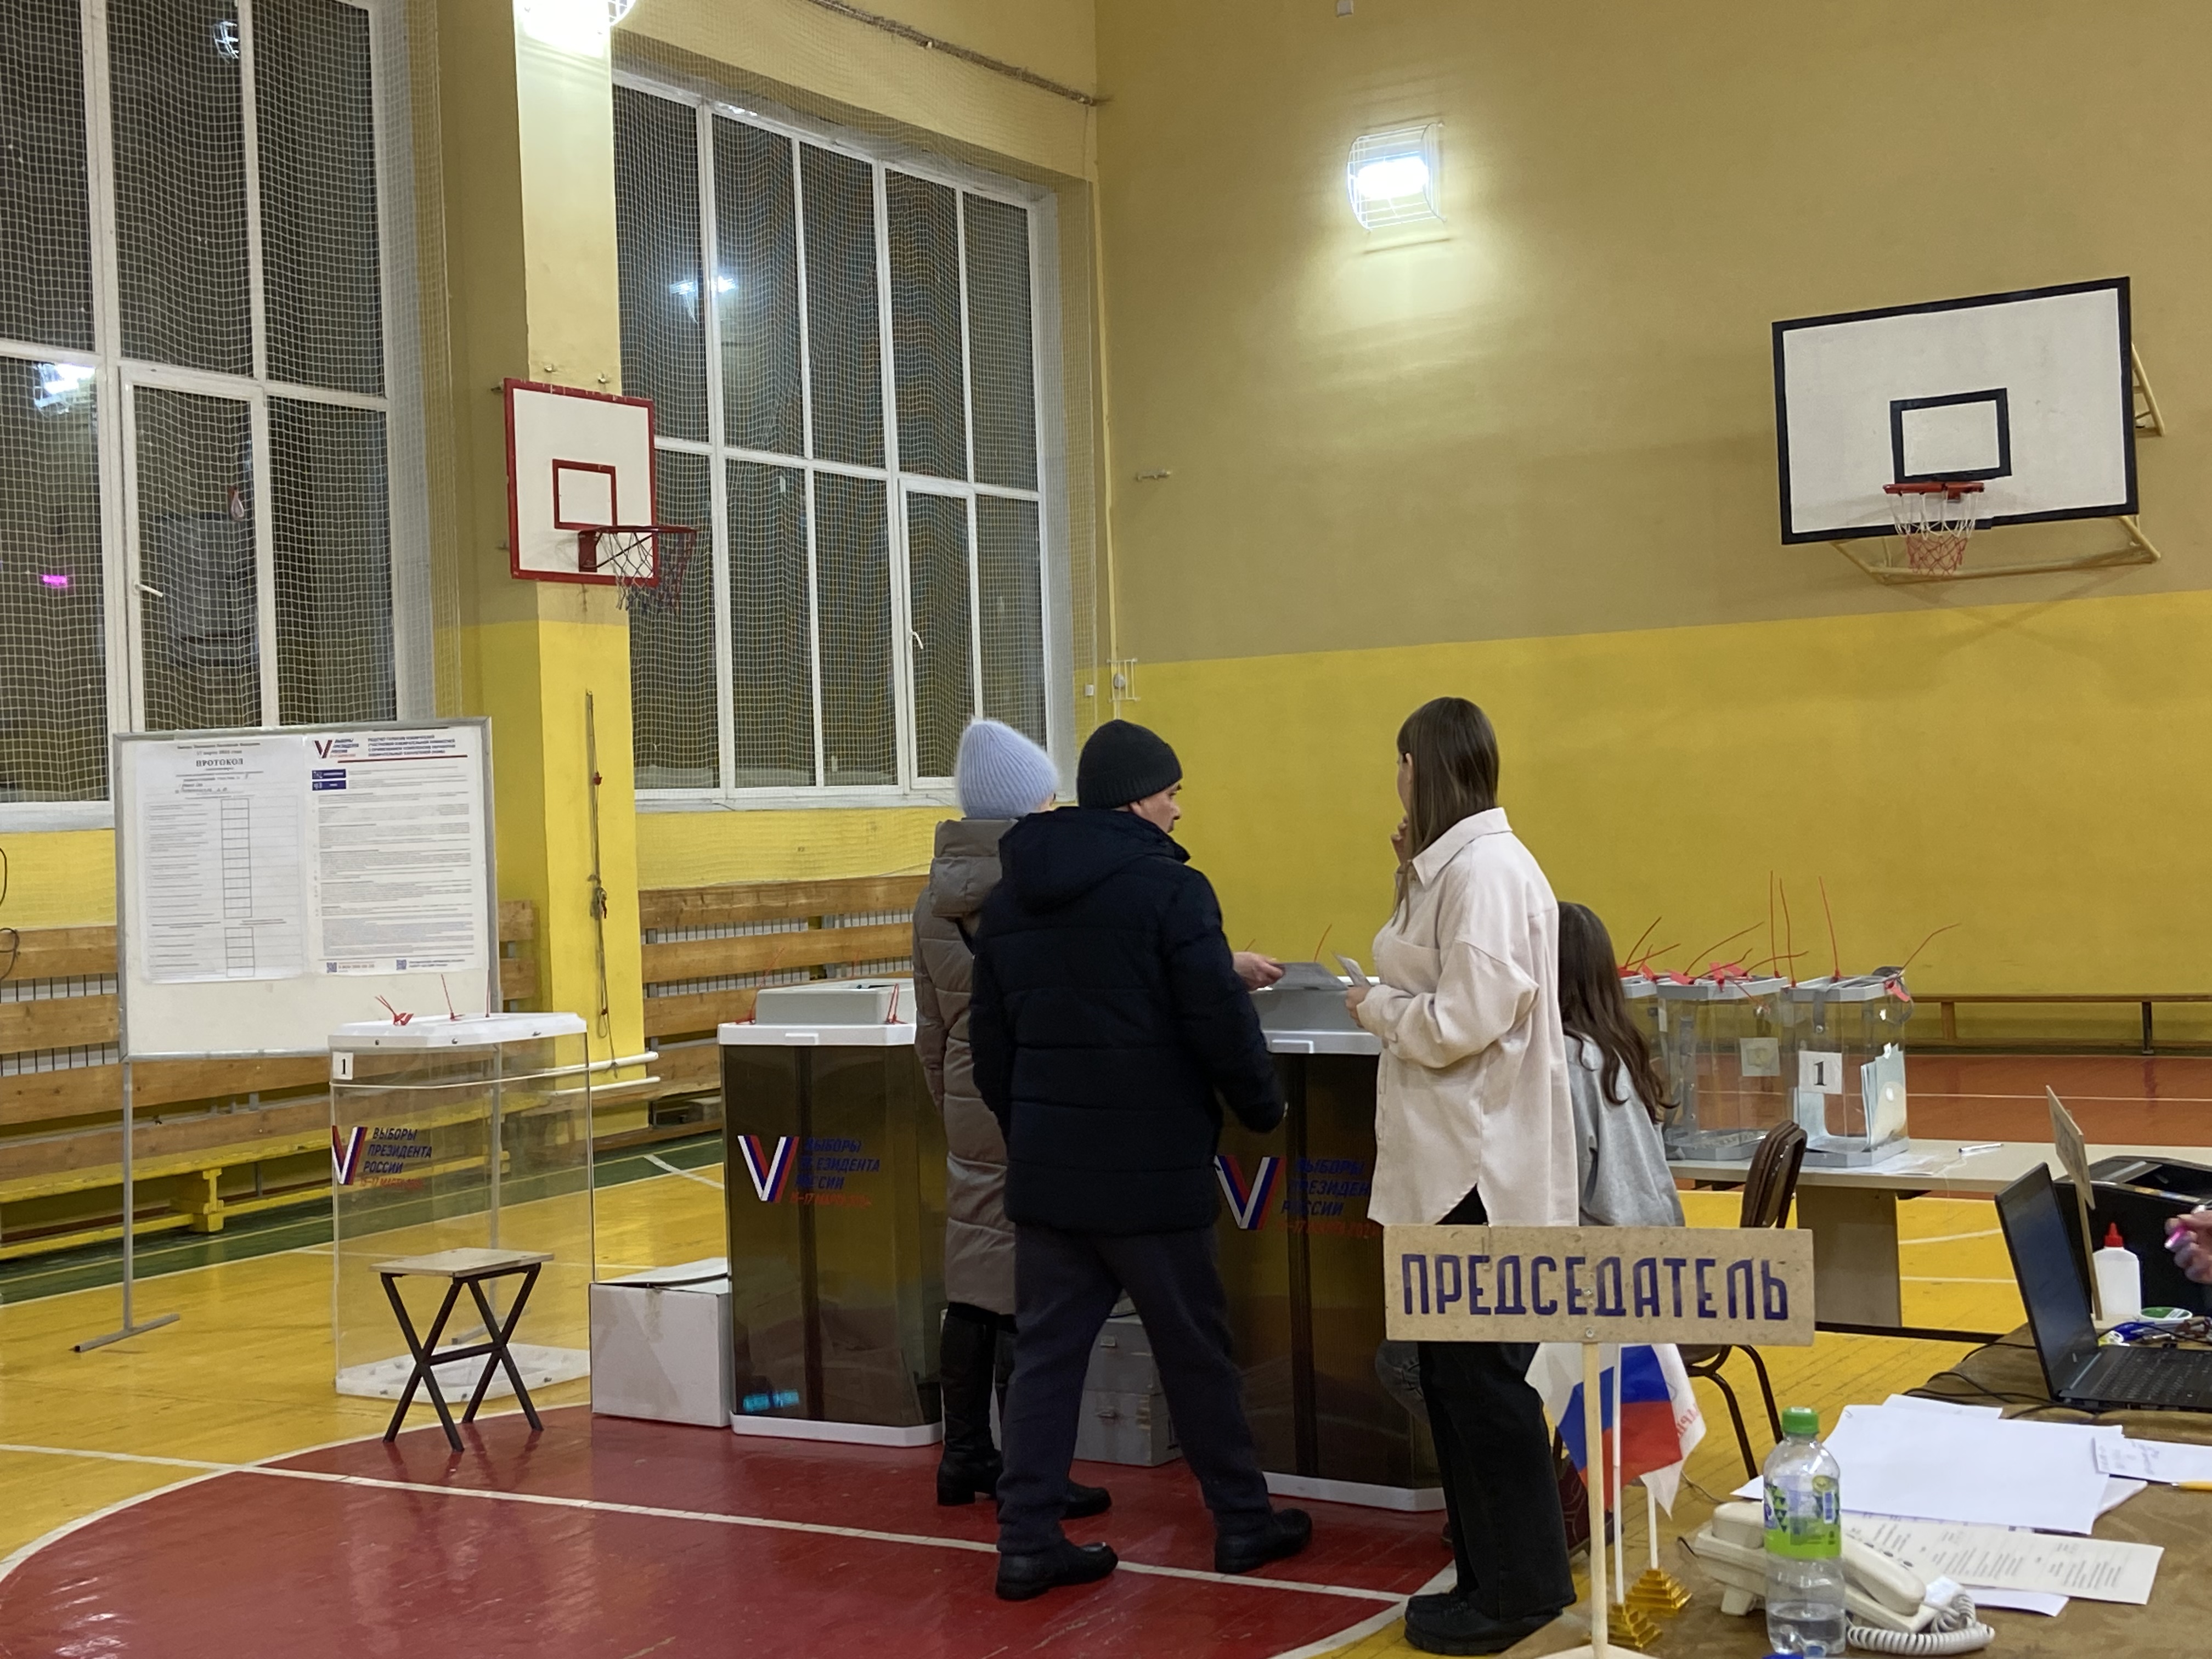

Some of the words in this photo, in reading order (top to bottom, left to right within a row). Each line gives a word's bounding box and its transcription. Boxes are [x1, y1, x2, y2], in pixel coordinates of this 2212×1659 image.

[196, 758, 243, 767] ПРОТОКОЛ
[341, 1058, 346, 1075] 1
[1814, 1061, 1827, 1086] 1
[373, 1127, 417, 1141] ВЫБОРЫ
[368, 1144, 432, 1159] ПРЕЗИДЕНТА
[364, 1161, 403, 1173] РОССИИ
[1402, 1254, 1789, 1321] ПРЕДСЕДАТЕЛЬ
